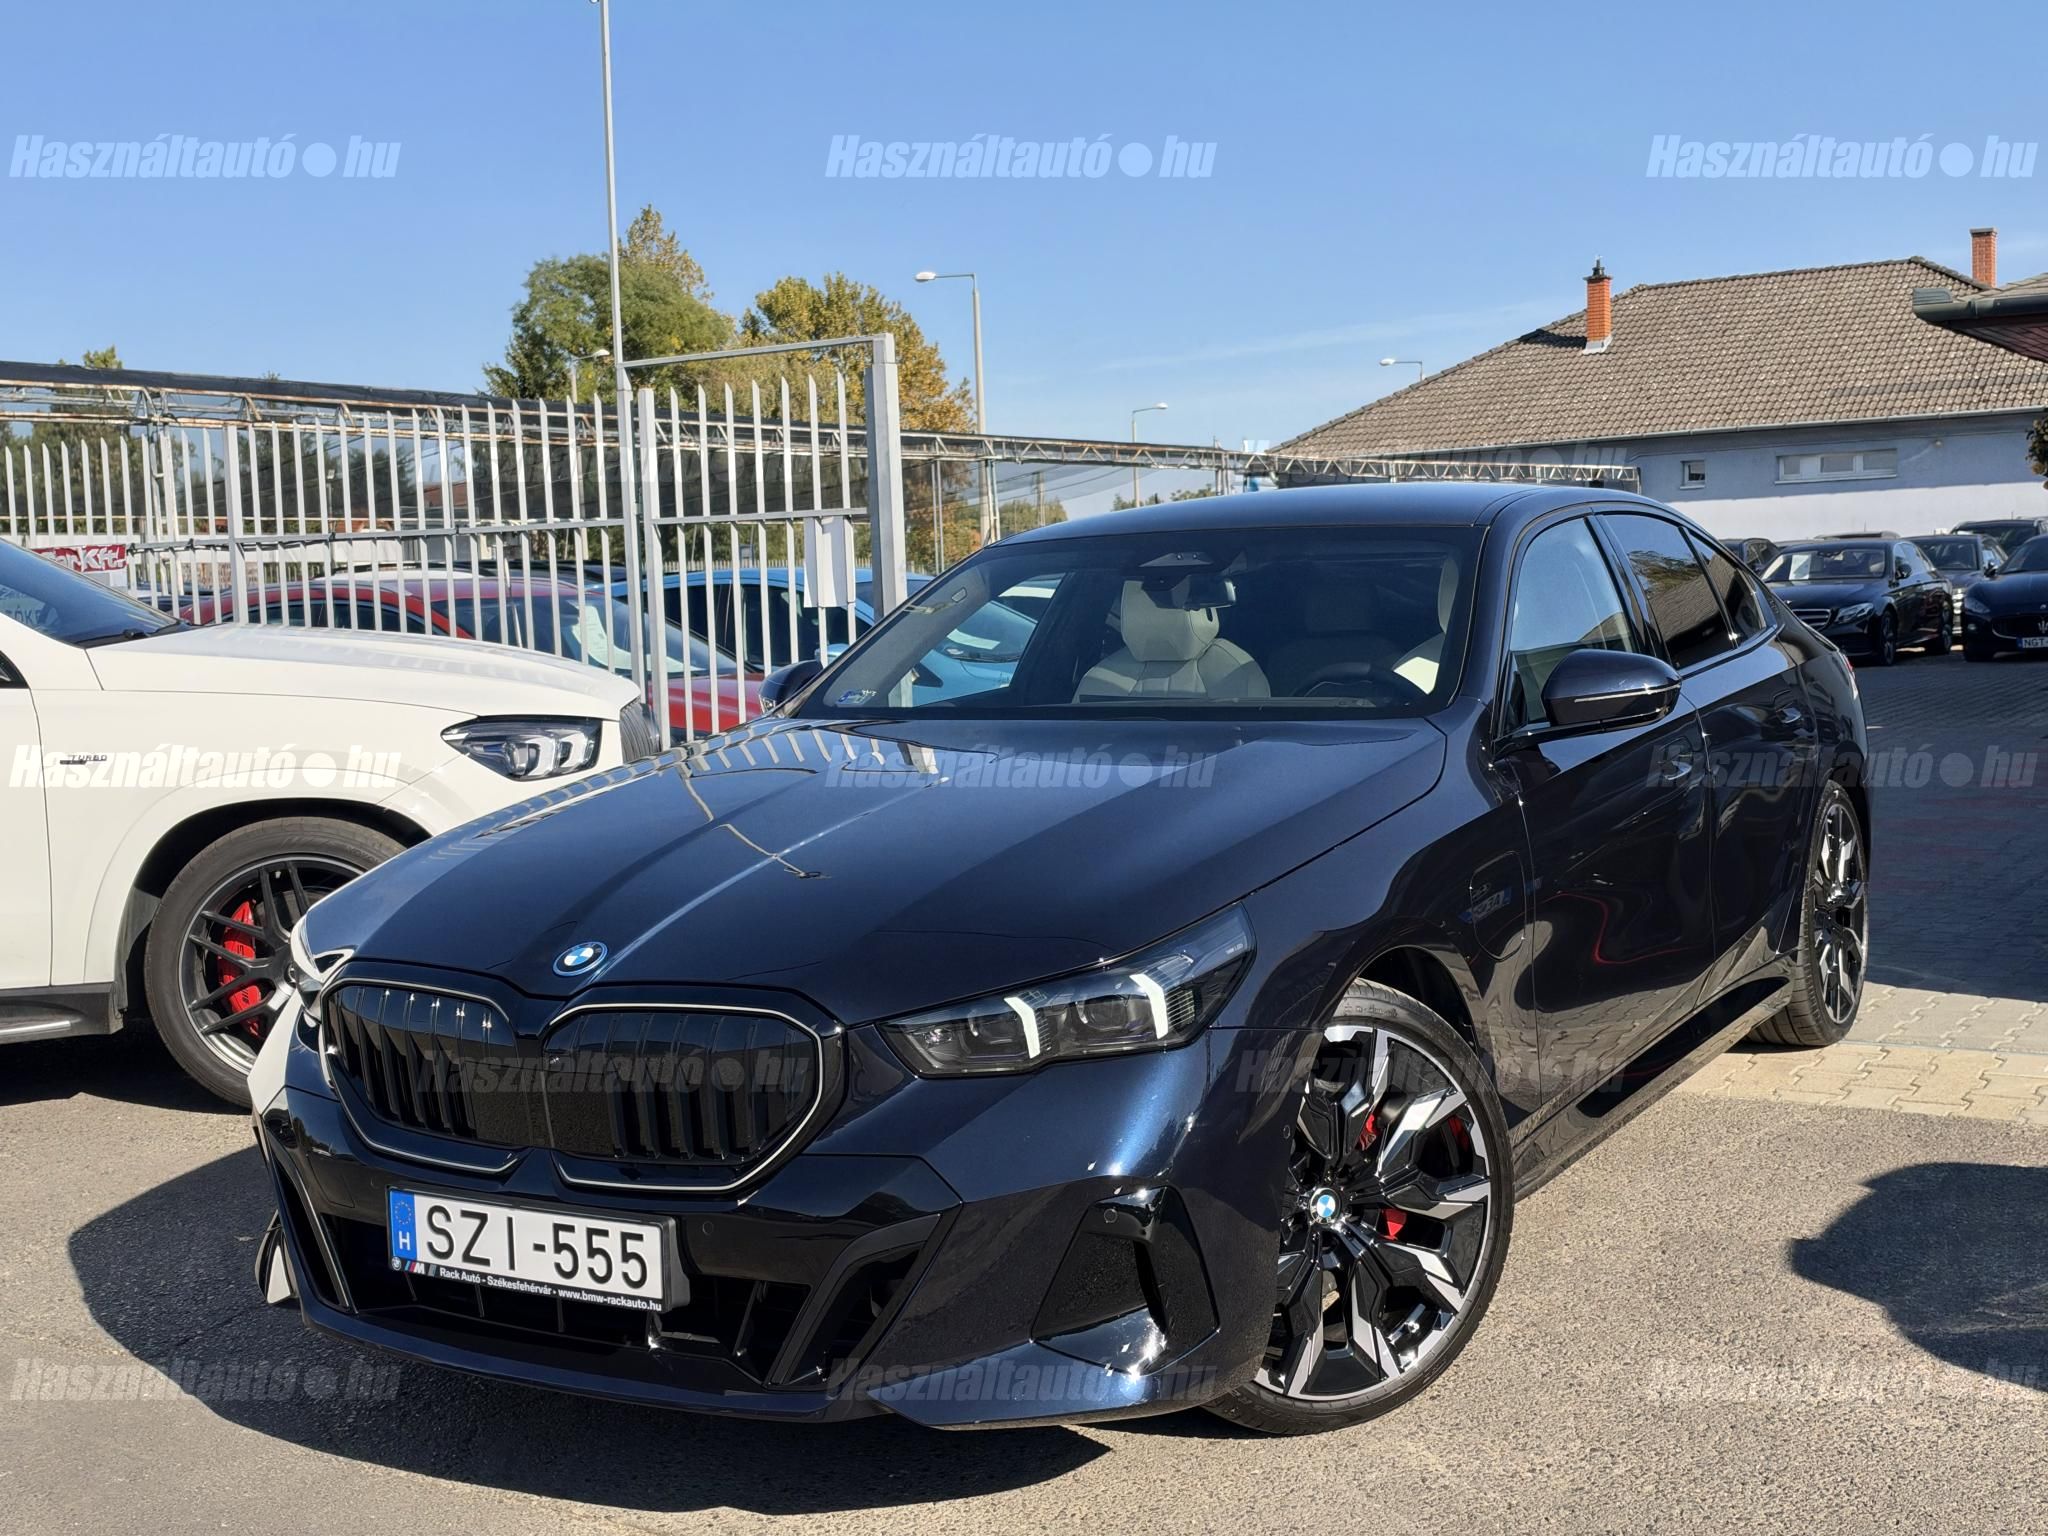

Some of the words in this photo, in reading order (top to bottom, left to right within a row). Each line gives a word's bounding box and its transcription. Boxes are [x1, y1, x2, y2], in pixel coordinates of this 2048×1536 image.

[398, 1230, 411, 1251] H
[427, 1204, 648, 1289] SZI-555
[440, 1267, 461, 1280] Rack
[461, 1271, 481, 1284] Autó
[487, 1275, 552, 1295] Székesfehérvár
[558, 1288, 662, 1311] www.bmw-rackauto.hu
